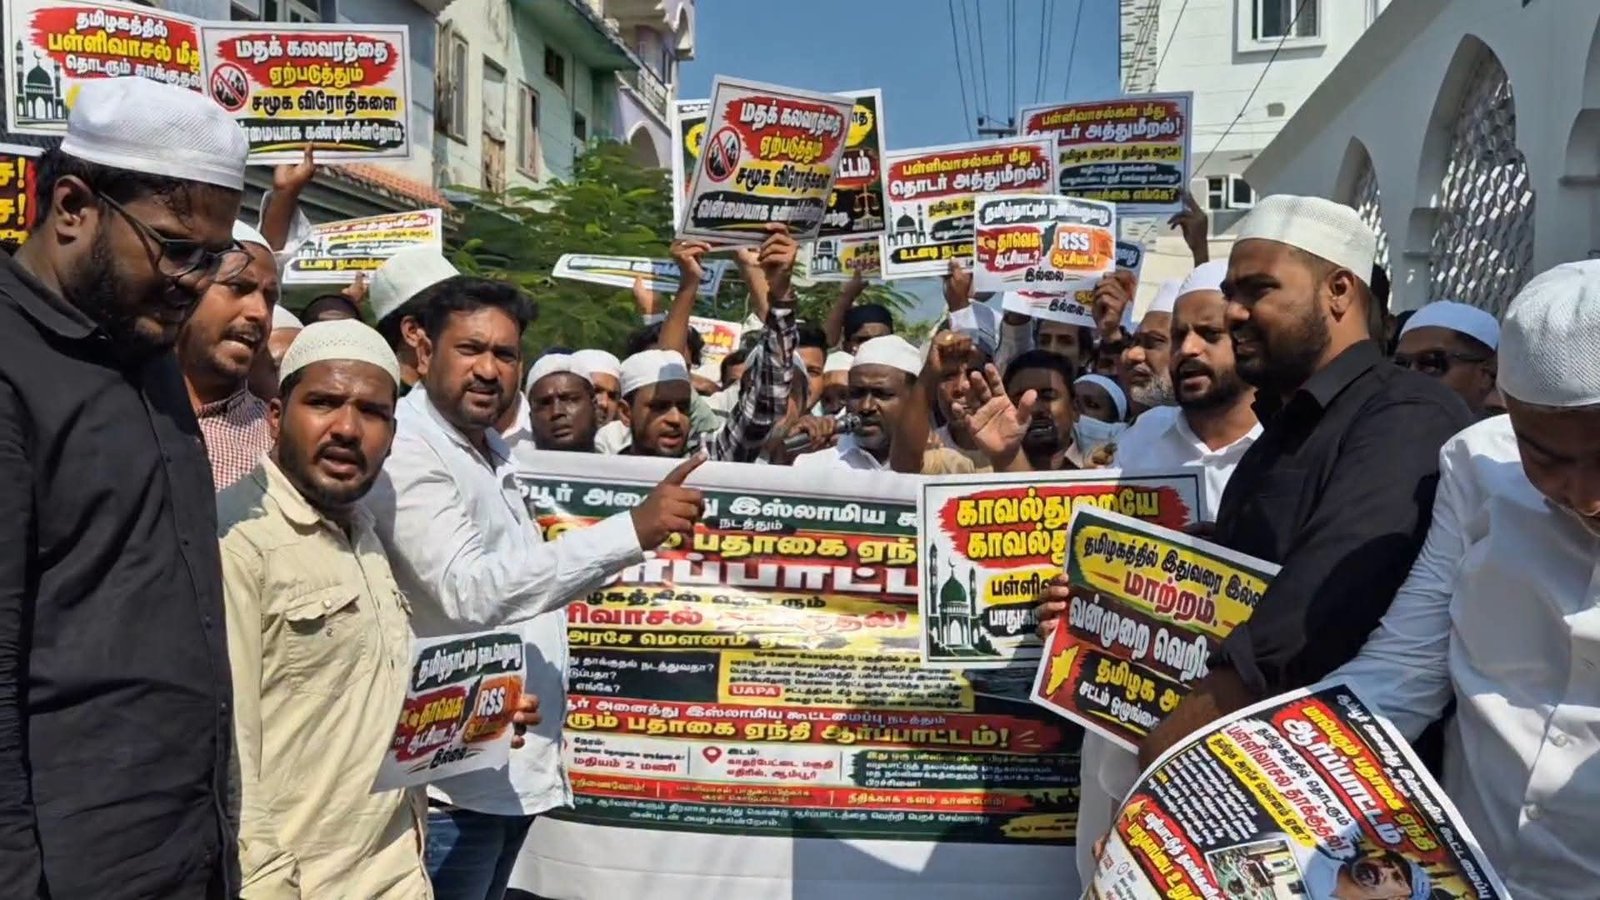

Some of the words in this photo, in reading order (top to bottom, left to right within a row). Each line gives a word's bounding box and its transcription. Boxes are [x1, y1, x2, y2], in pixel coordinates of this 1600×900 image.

[76, 10, 168, 38] தமிழகத்தில்
[48, 28, 172, 62] பள்ளிவாசல்
[235, 35, 283, 63] மதக்
[287, 36, 388, 63] கலவரத்தை
[65, 54, 131, 77] தொடரும்
[269, 62, 364, 87] ஏற்படுத்தும்
[252, 95, 294, 116] சமூக
[298, 90, 397, 115] விரோதிகளை
[740, 101, 778, 130] மதக்
[902, 151, 1004, 176] பள்ளிவாசல்கள்
[1008, 147, 1031, 165] மீது
[736, 167, 771, 191] சமூக
[890, 173, 948, 199] தொடர்
[952, 162, 1047, 191] அத்துமீறல்!
[1059, 232, 1089, 250] RSS
[1025, 267, 1064, 282] இல்லை
[719, 518, 783, 532] நடத்தும்
[729, 496, 886, 525] இஸ்லாமிய
[694, 532, 848, 558] பதாகை
[858, 538, 917, 565] ஏந்
[1084, 531, 1159, 568] தமிழகத்தில்
[1161, 549, 1222, 596] இதுவரை
[1123, 570, 1219, 628] மாற்றம்.
[1068, 593, 1150, 660] வன்முறை
[1153, 628, 1211, 682] வெறி
[583, 656, 638, 669] தாக்குதல்
[641, 661, 714, 673] நடத்துவதா?
[1096, 657, 1155, 701] தமிழக
[477, 687, 506, 716] RSS
[732, 685, 777, 696] UAPA
[1080, 682, 1110, 711] சட்டம்
[596, 700, 679, 718] அனைத்து
[685, 705, 783, 720] இஸ்லாமிய
[786, 710, 882, 727] கூட்டமைப்பு
[567, 712, 618, 730] ரும்
[628, 716, 736, 734] பதாகை
[744, 720, 812, 741] ஏந்தி
[821, 724, 1009, 748] ஆர்ப்பாட்டம்!
[574, 756, 620, 768] மதியம்
[1227, 725, 1297, 787] பள்ளிவாசல்
[1282, 784, 1350, 852] தாக்குதல்!
[1256, 727, 1307, 779] தமிழகத்தில்
[1306, 779, 1352, 827] தொடரும்
[1283, 718, 1402, 845] ஆர்ப்பாட்டம்
[1302, 705, 1360, 757] மாபெரும்
[1355, 753, 1405, 811] பதாகை
[1396, 813, 1438, 851] ஏந்தி
[1285, 815, 1312, 842] ஏன்?
